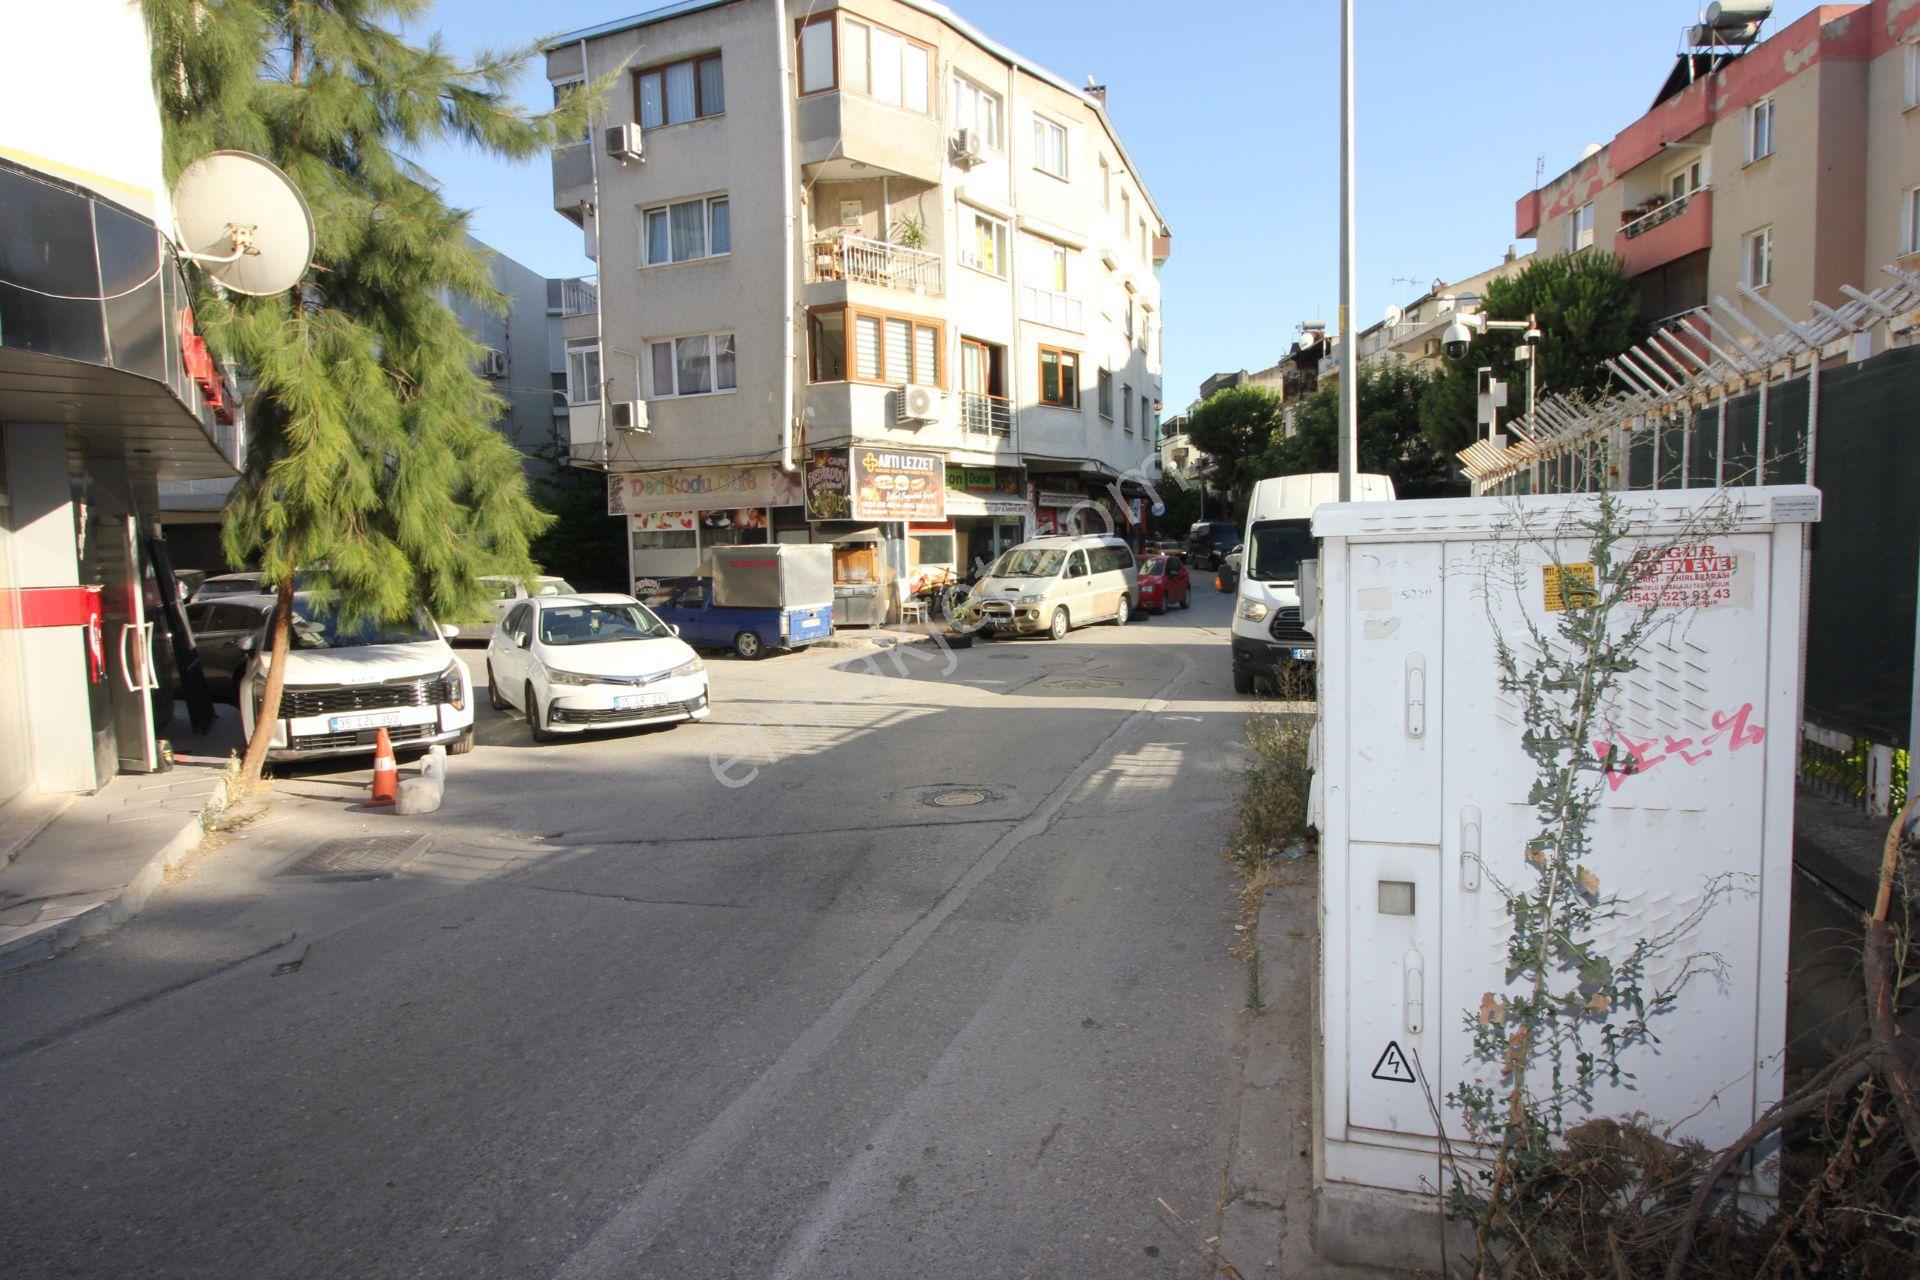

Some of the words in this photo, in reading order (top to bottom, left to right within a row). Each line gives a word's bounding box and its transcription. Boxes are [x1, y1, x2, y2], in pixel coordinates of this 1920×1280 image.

[879, 454, 899, 469] ARTI
[901, 456, 934, 471] LEZZET
[969, 472, 990, 484] Durak
[1692, 558, 1729, 573] EVE
[1663, 591, 1687, 601] 523
[1714, 588, 1731, 599] 43
